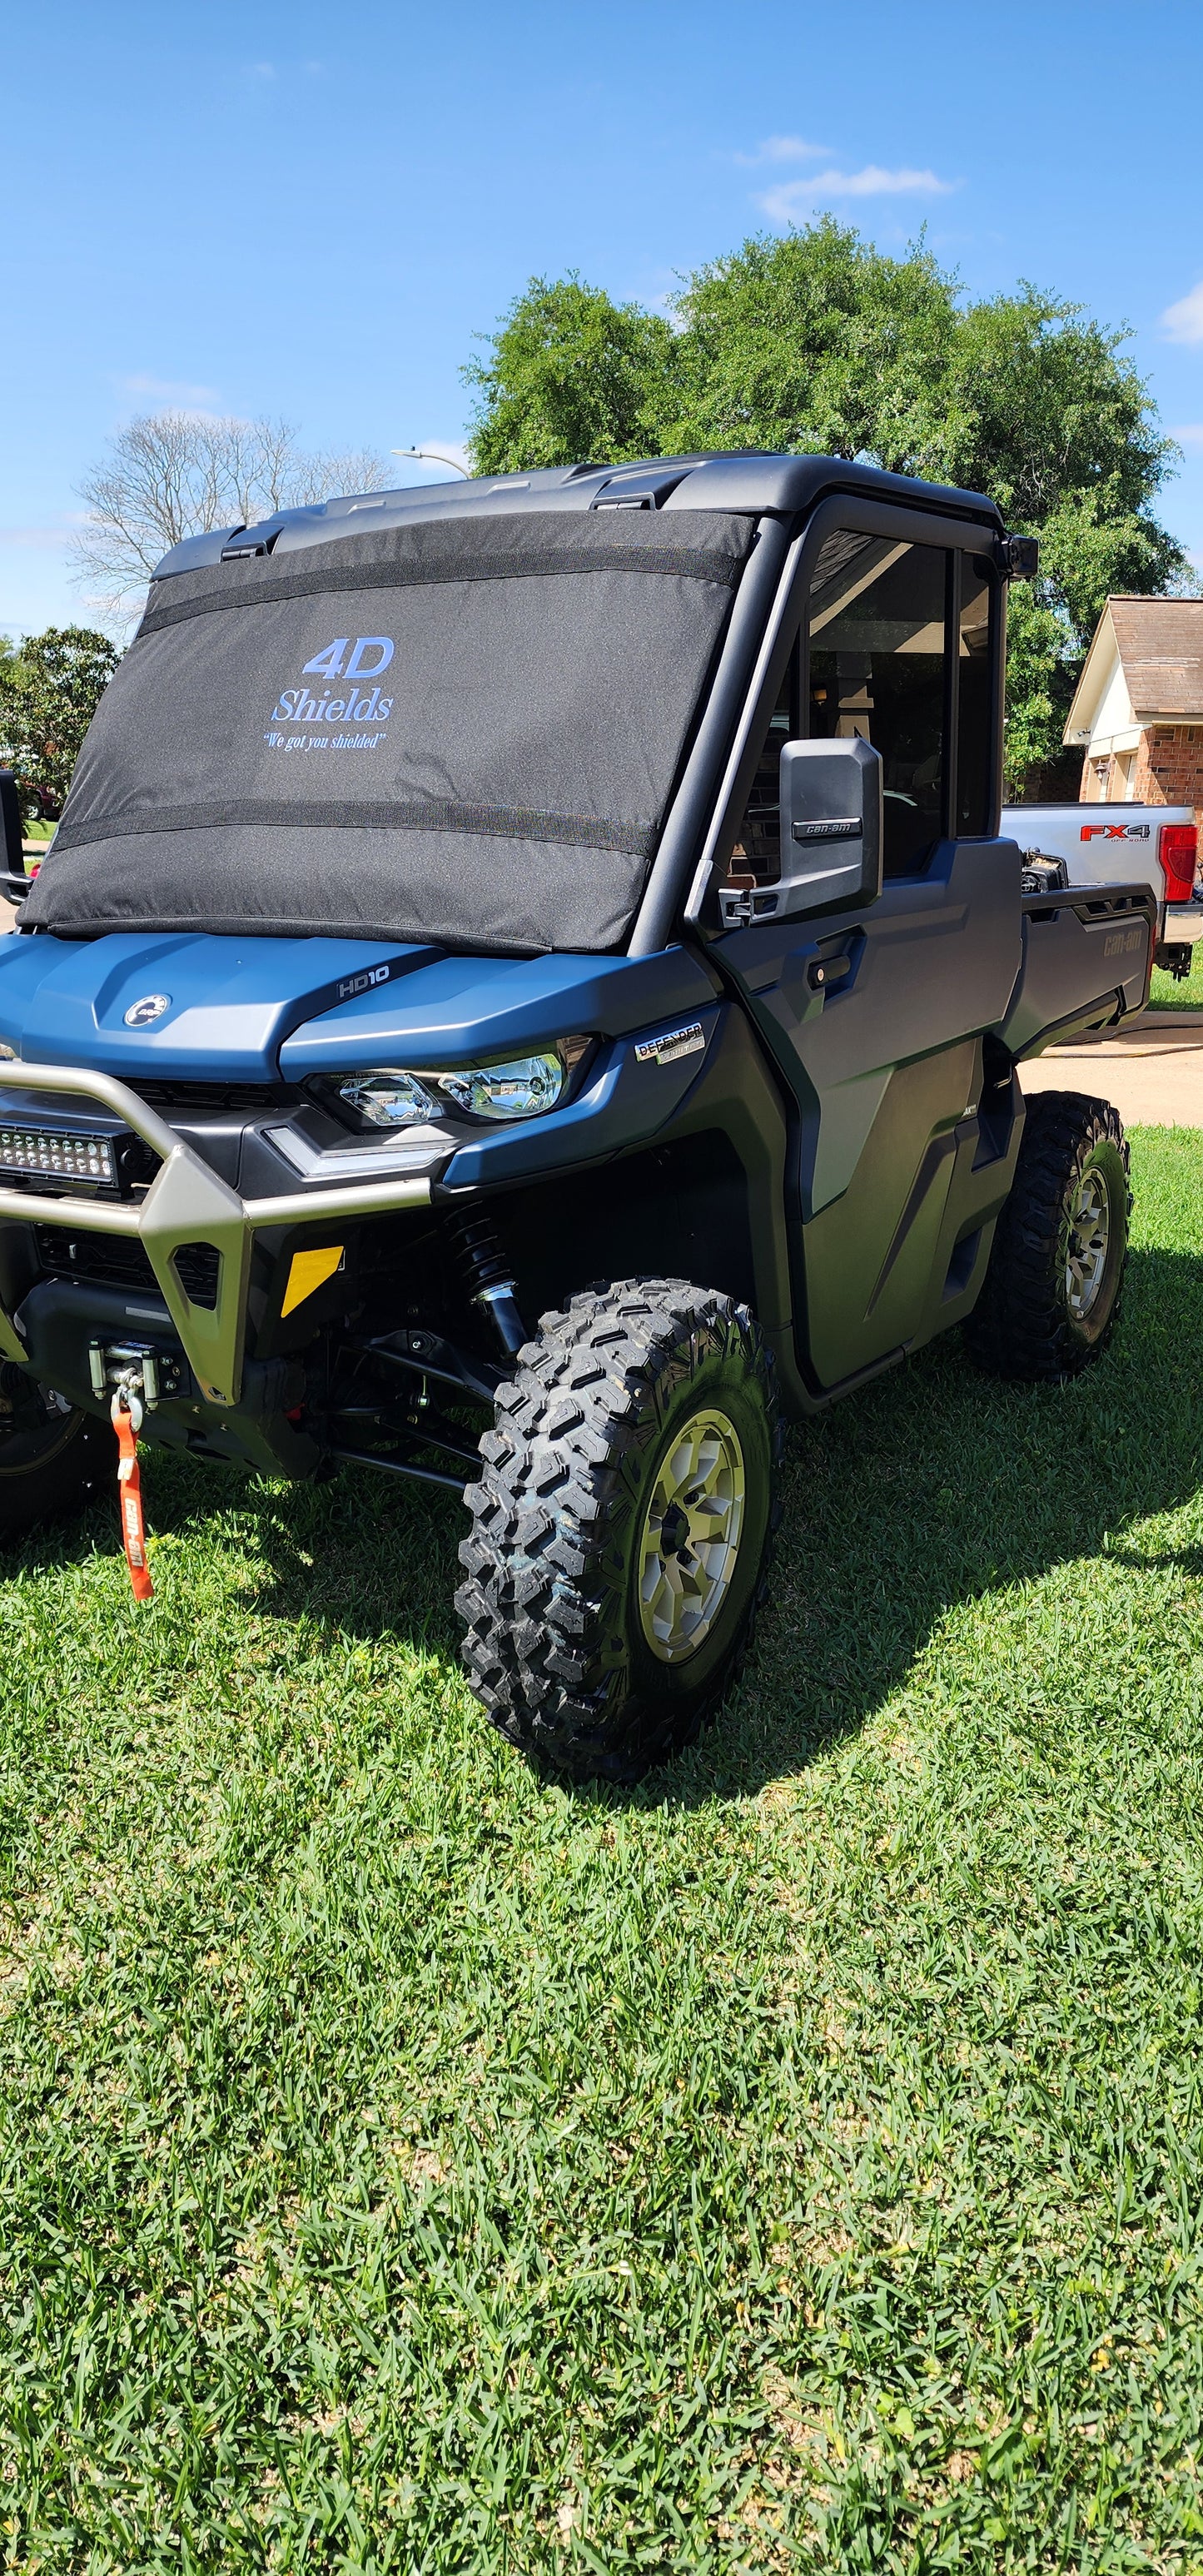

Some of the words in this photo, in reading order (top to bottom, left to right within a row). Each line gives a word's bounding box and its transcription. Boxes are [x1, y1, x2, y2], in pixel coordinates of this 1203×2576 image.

[301, 636, 395, 679] 4D
[271, 687, 394, 722] Shields
[284, 734, 307, 752] got
[304, 737, 329, 752] you
[806, 823, 851, 834] can-am
[1080, 824, 1151, 842] FX4
[1103, 930, 1142, 957] can-am
[338, 965, 390, 998] HD10
[639, 1024, 703, 1057] DEFENDER
[124, 1497, 144, 1567] can-am
